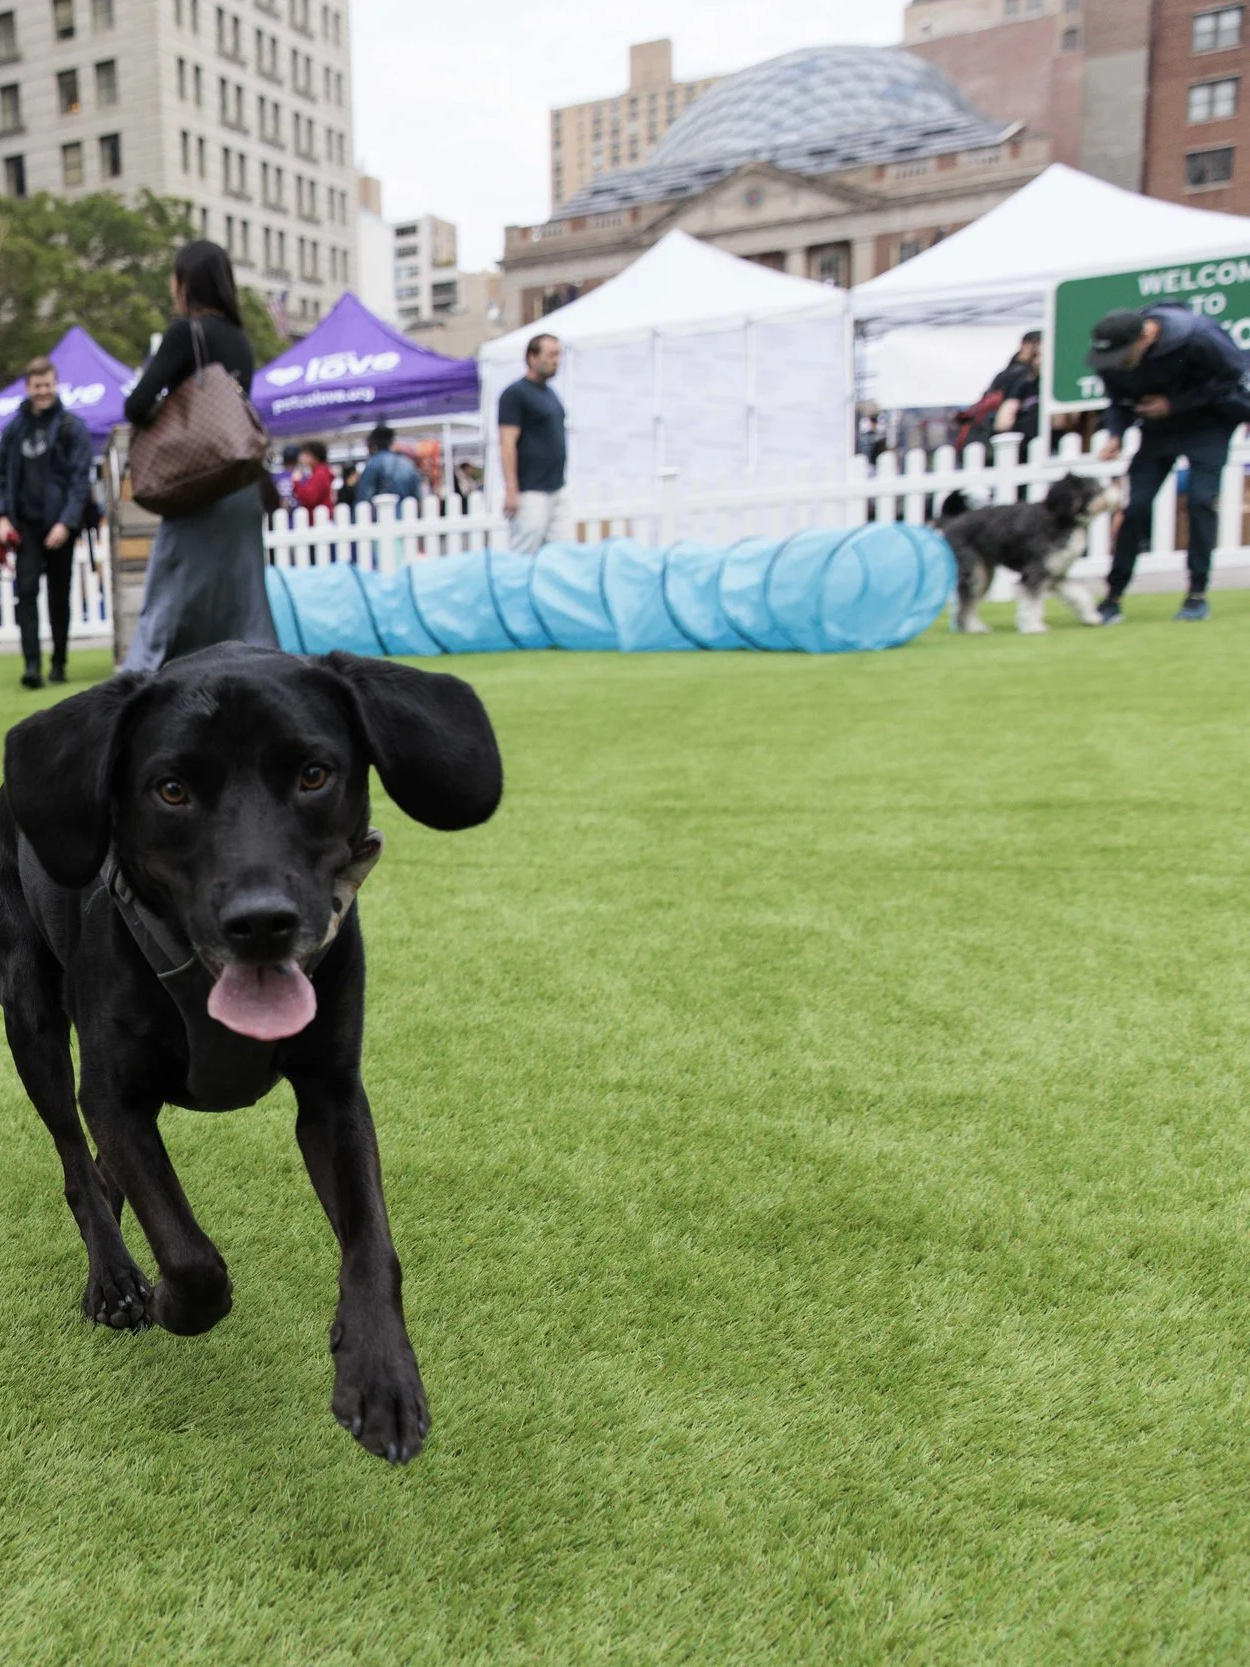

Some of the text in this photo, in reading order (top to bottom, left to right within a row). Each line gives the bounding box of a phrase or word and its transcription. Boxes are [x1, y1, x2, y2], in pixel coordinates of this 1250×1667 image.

[1188, 291, 1227, 317] TO
[304, 351, 402, 385] love
[57, 382, 107, 407] ve
